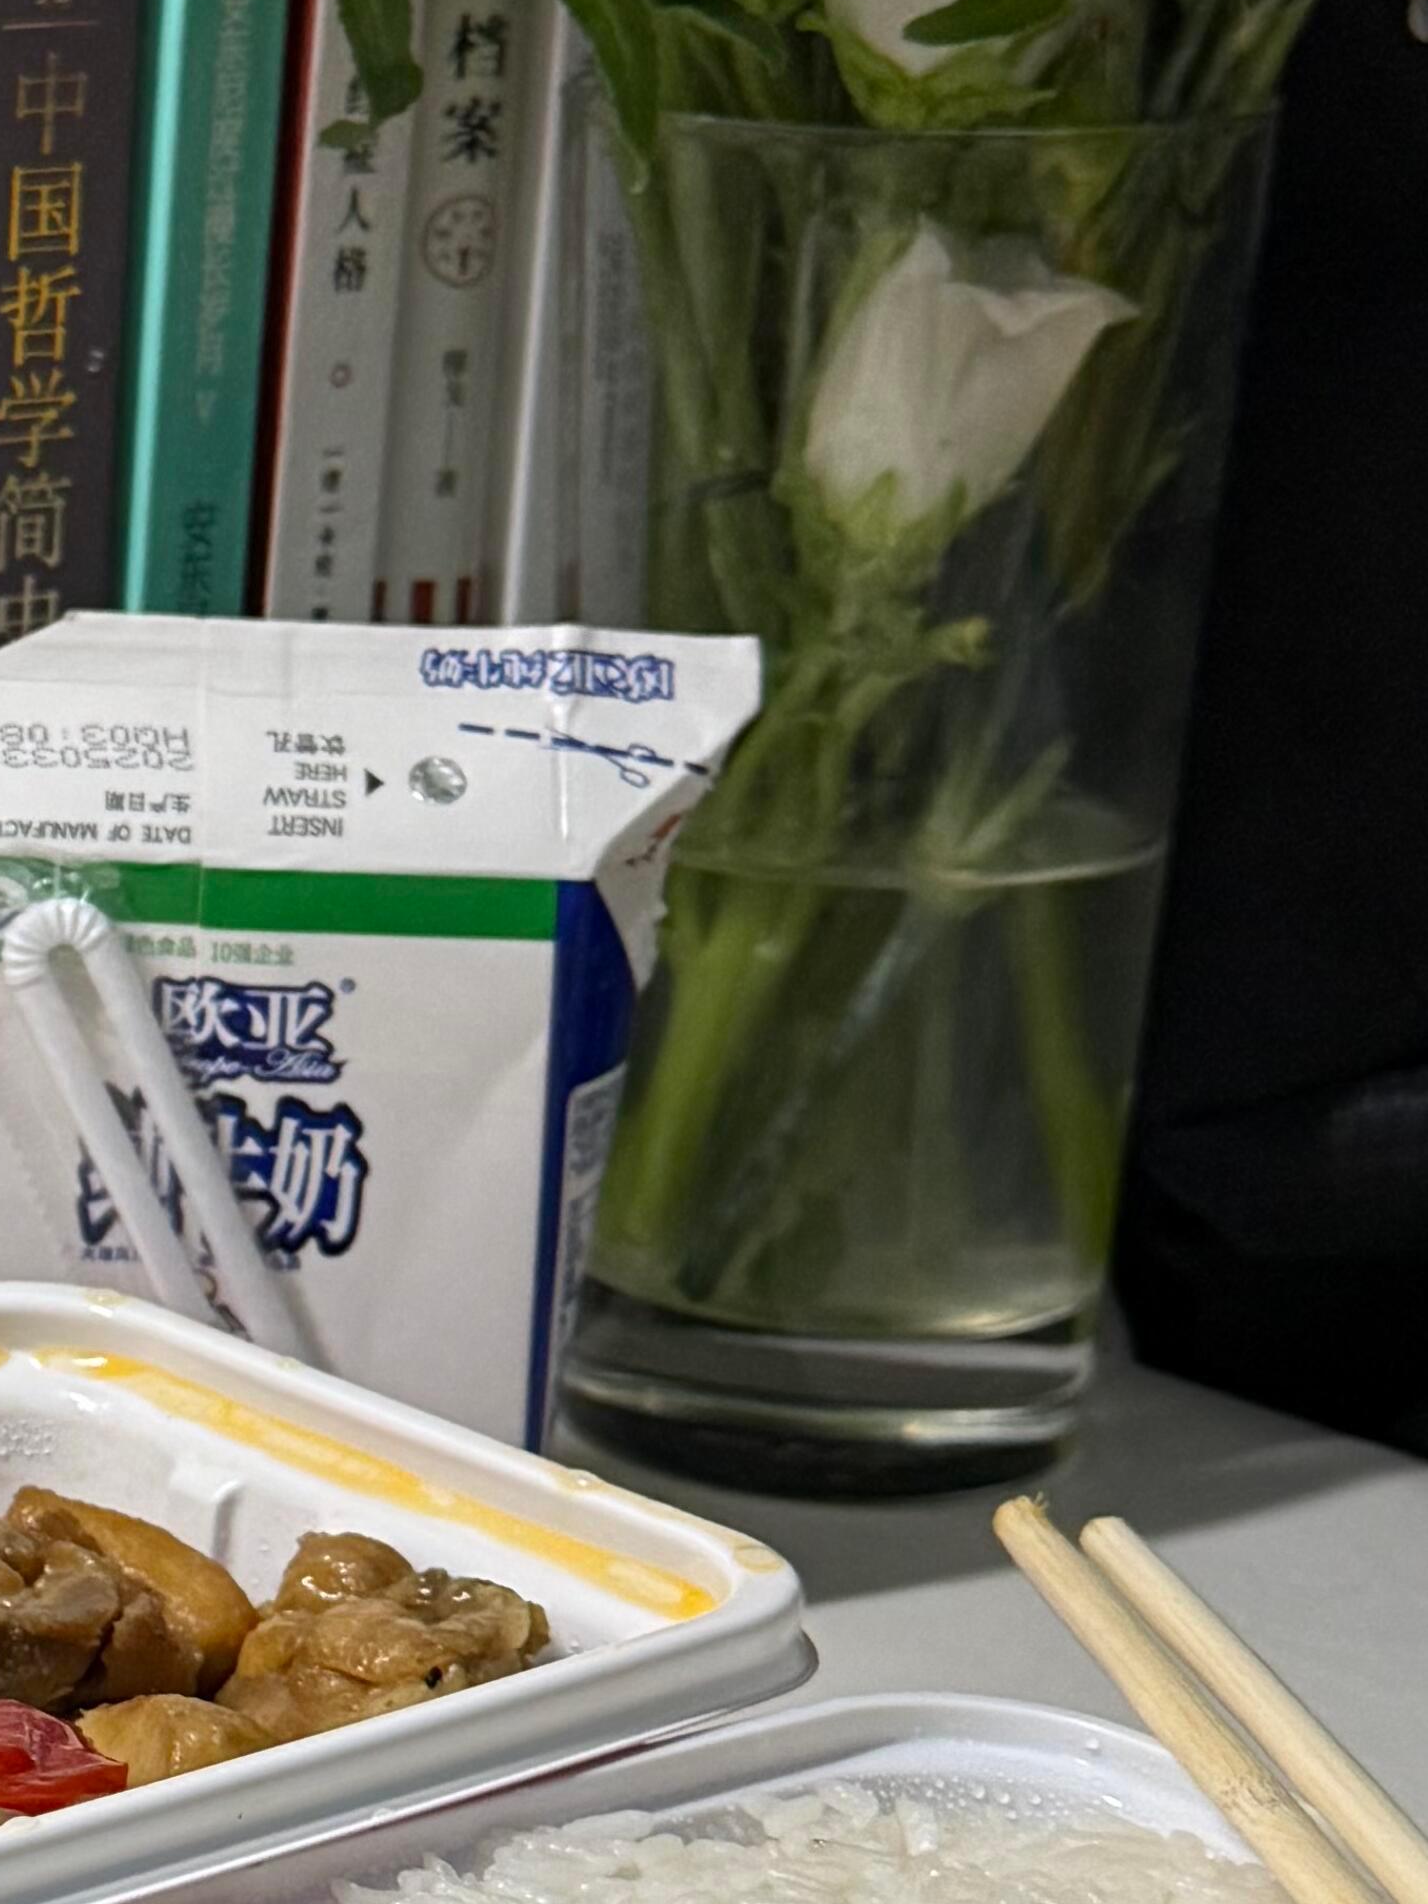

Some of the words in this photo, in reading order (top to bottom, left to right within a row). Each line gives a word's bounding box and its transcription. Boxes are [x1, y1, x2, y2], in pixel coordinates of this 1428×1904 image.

[293, 760, 347, 783] HERE
[104, 790, 192, 813] 生产日期
[262, 787, 347, 809] STRAW
[108, 824, 131, 843] OF
[143, 825, 192, 844] DATE
[267, 813, 345, 836] INSERT
[158, 976, 338, 1052] 欧亚
